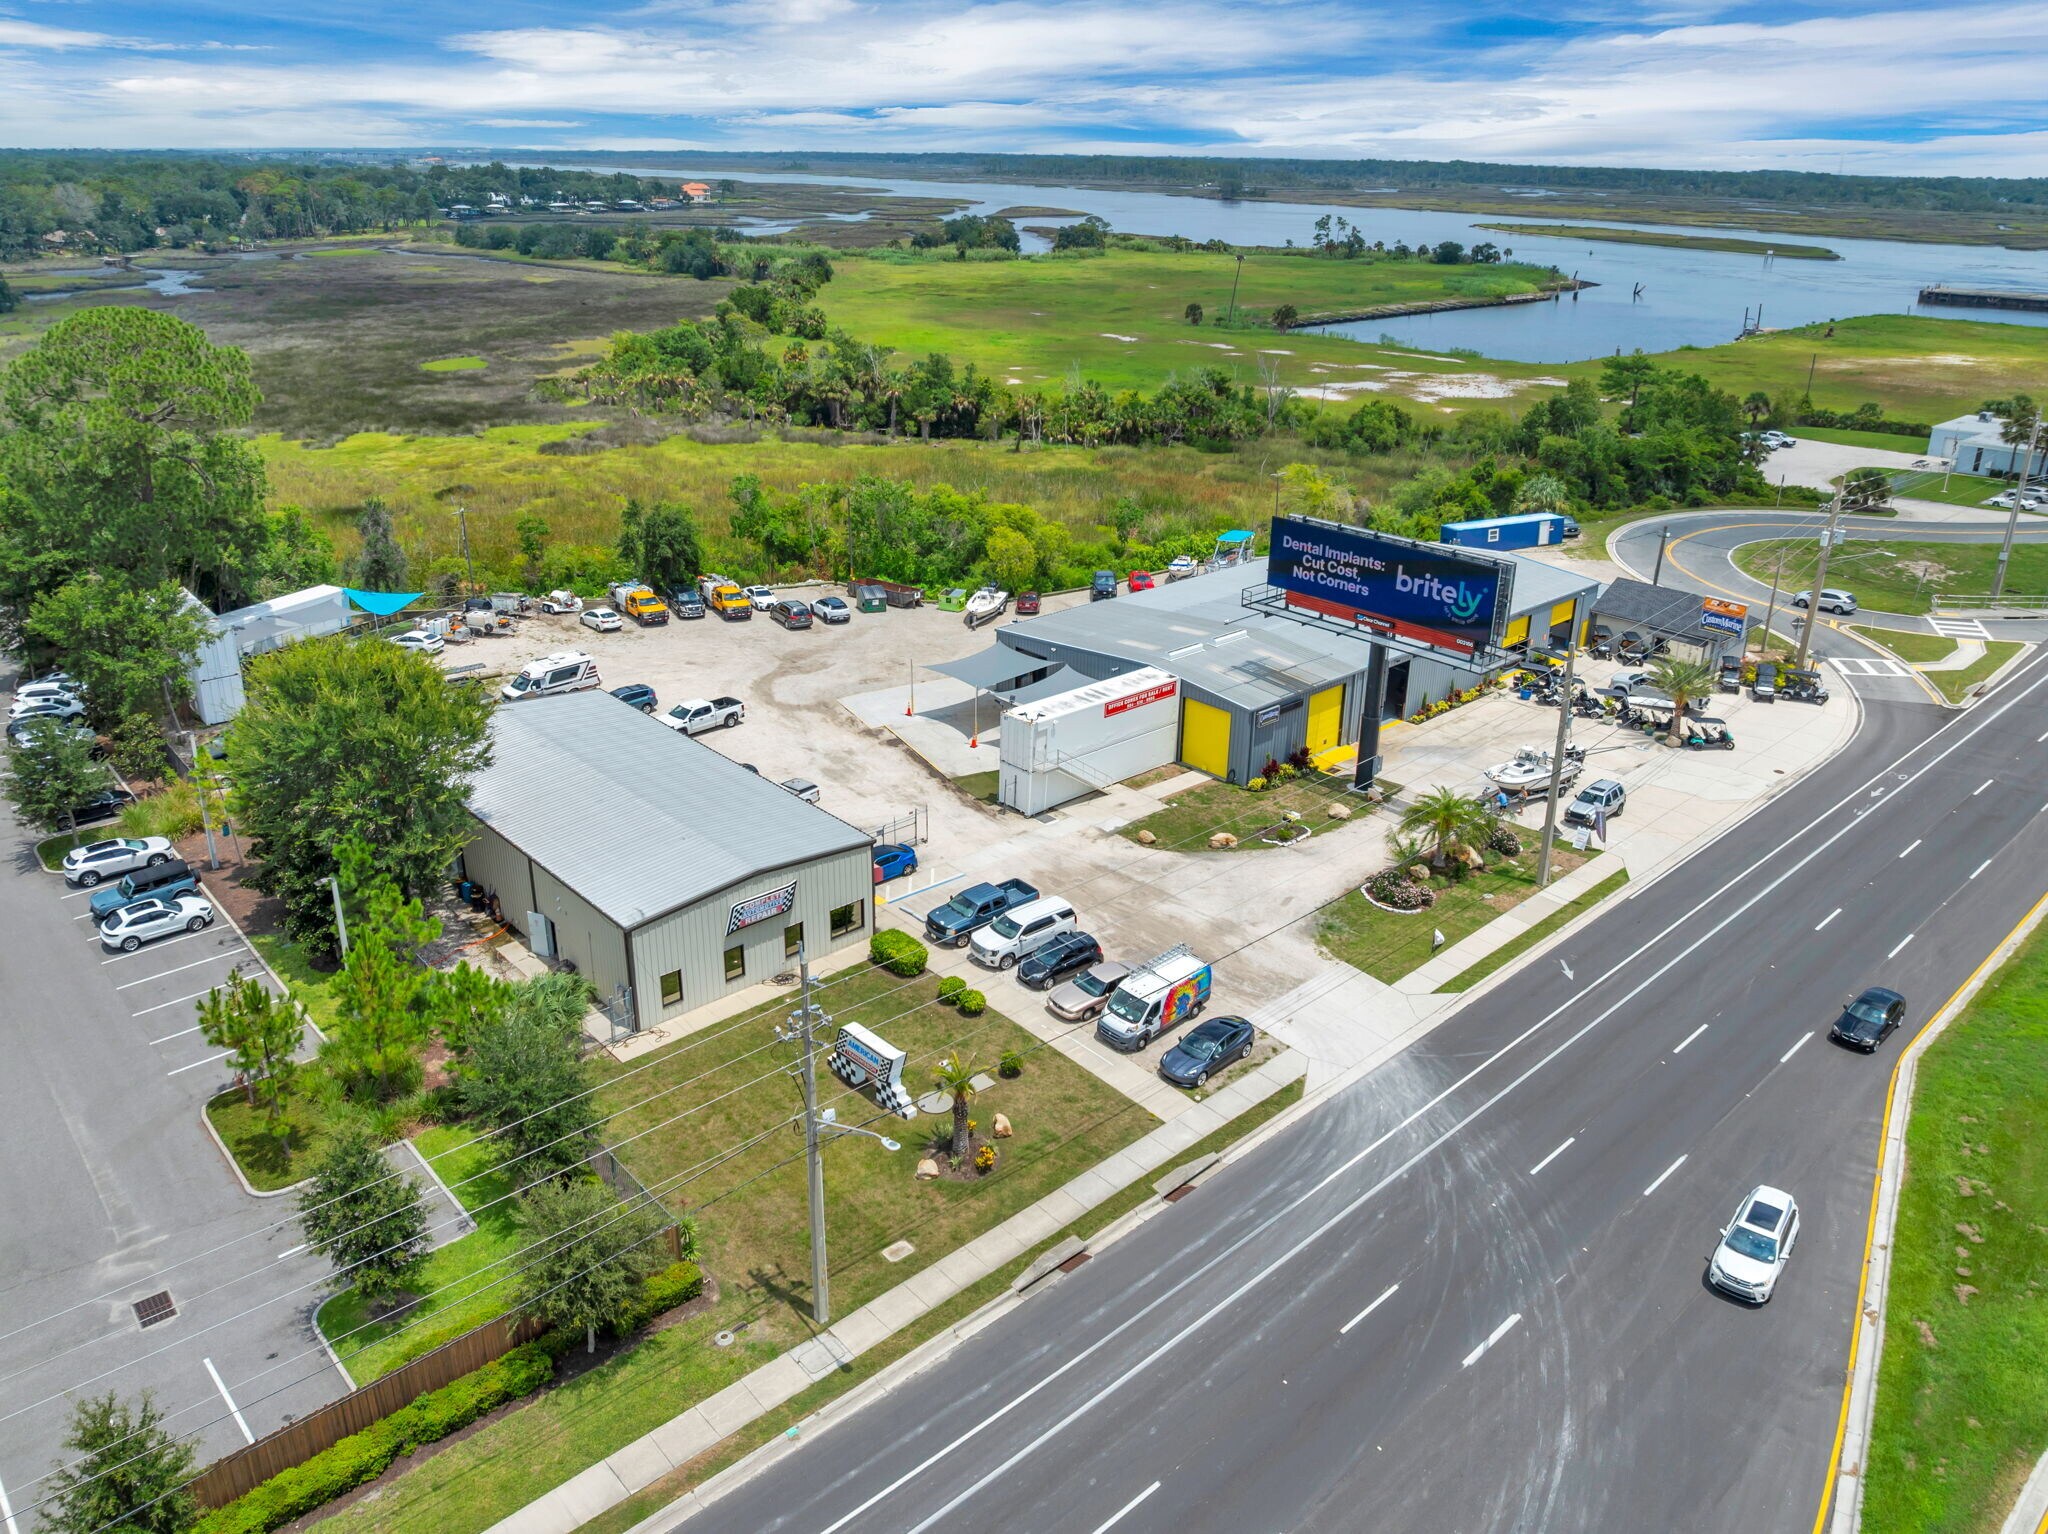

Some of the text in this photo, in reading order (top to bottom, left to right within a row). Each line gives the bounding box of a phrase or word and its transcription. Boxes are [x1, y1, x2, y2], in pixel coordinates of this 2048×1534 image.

[1283, 536, 1386, 571] Dental Implants:
[1293, 565, 1369, 596] Not Corners
[1303, 555, 1361, 582] Cut Cost,
[1396, 564, 1483, 617] britely
[742, 896, 785, 919] AUTOMOTIVE
[744, 890, 786, 910] COMPLETE
[745, 907, 778, 924] REPAIR
[847, 1039, 879, 1066] AMERICAN
